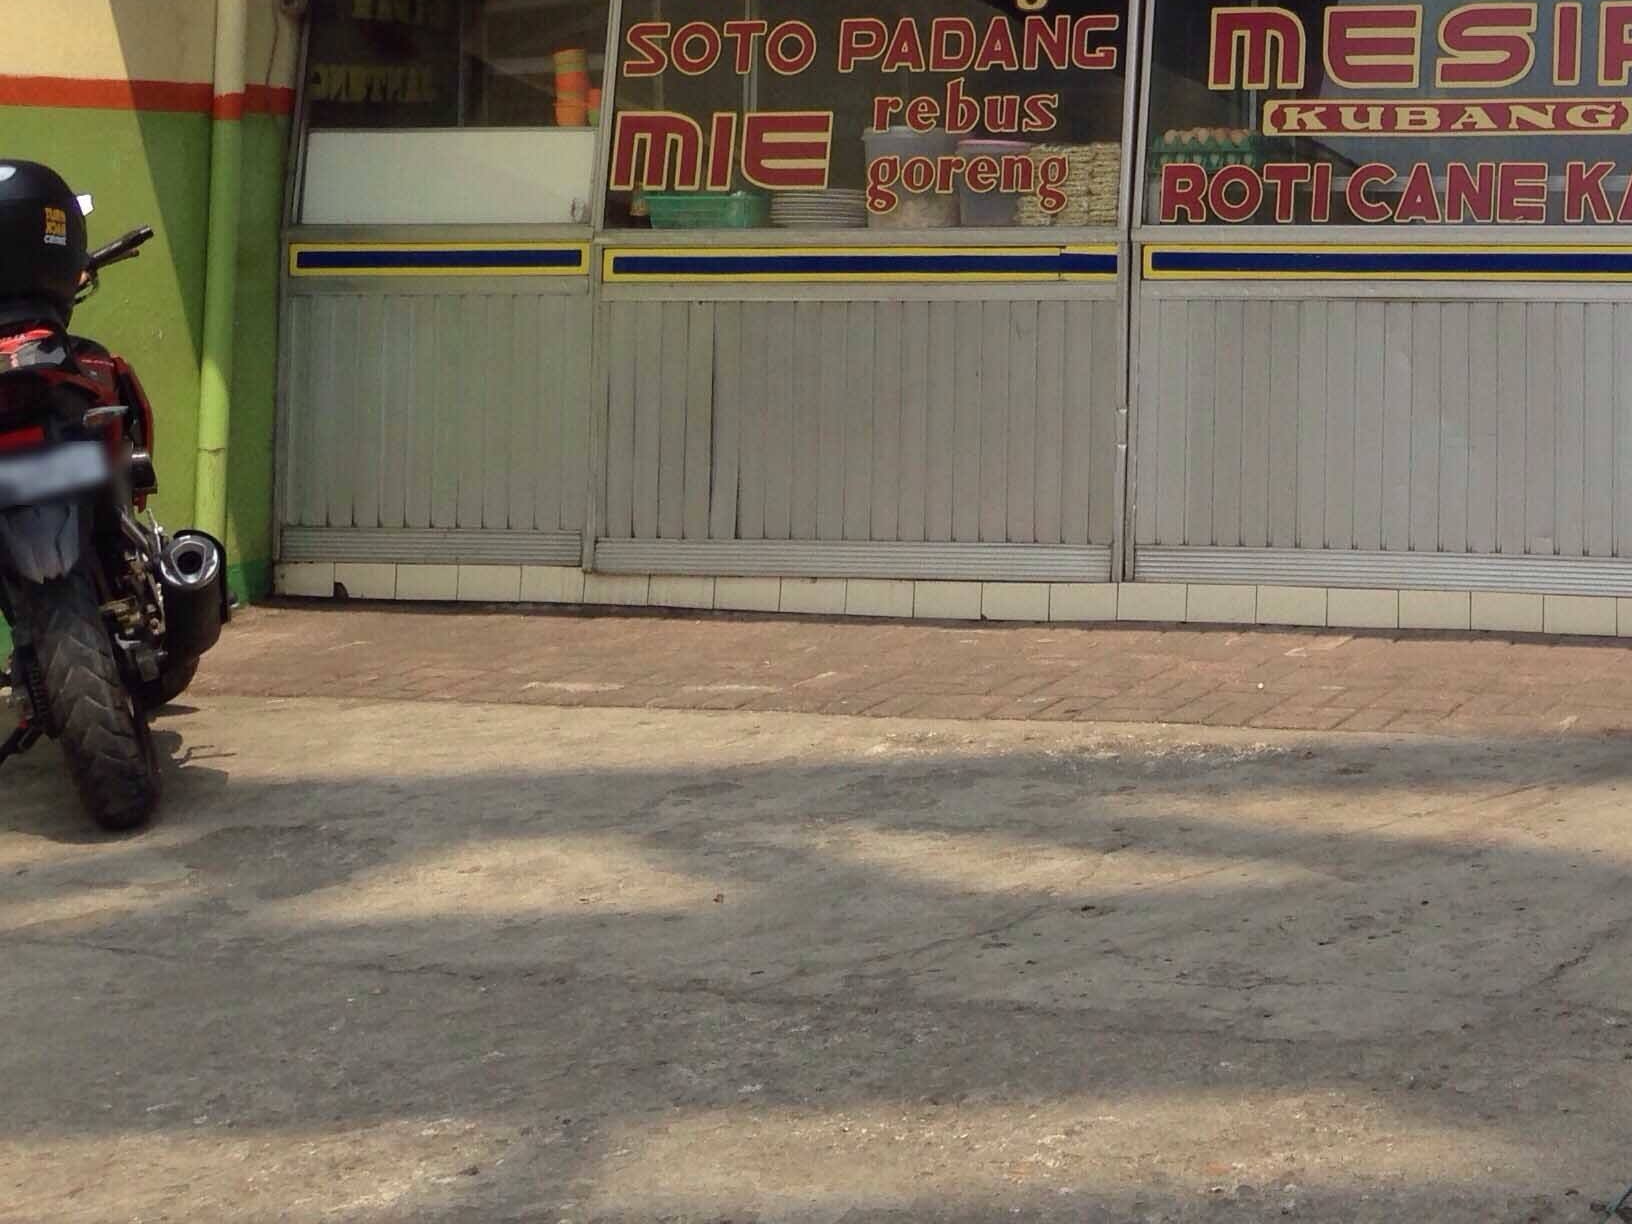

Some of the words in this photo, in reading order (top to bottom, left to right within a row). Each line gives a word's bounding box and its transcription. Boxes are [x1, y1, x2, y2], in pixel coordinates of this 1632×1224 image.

[623, 19, 817, 77] SOTO
[837, 15, 1119, 73] PADANG
[873, 76, 1059, 134] rebus
[1280, 103, 1619, 133] KUBANG
[609, 110, 834, 192] MIE
[866, 152, 1069, 214] goreng
[1159, 162, 1333, 224] ROTI
[1345, 162, 1550, 224] CANE
